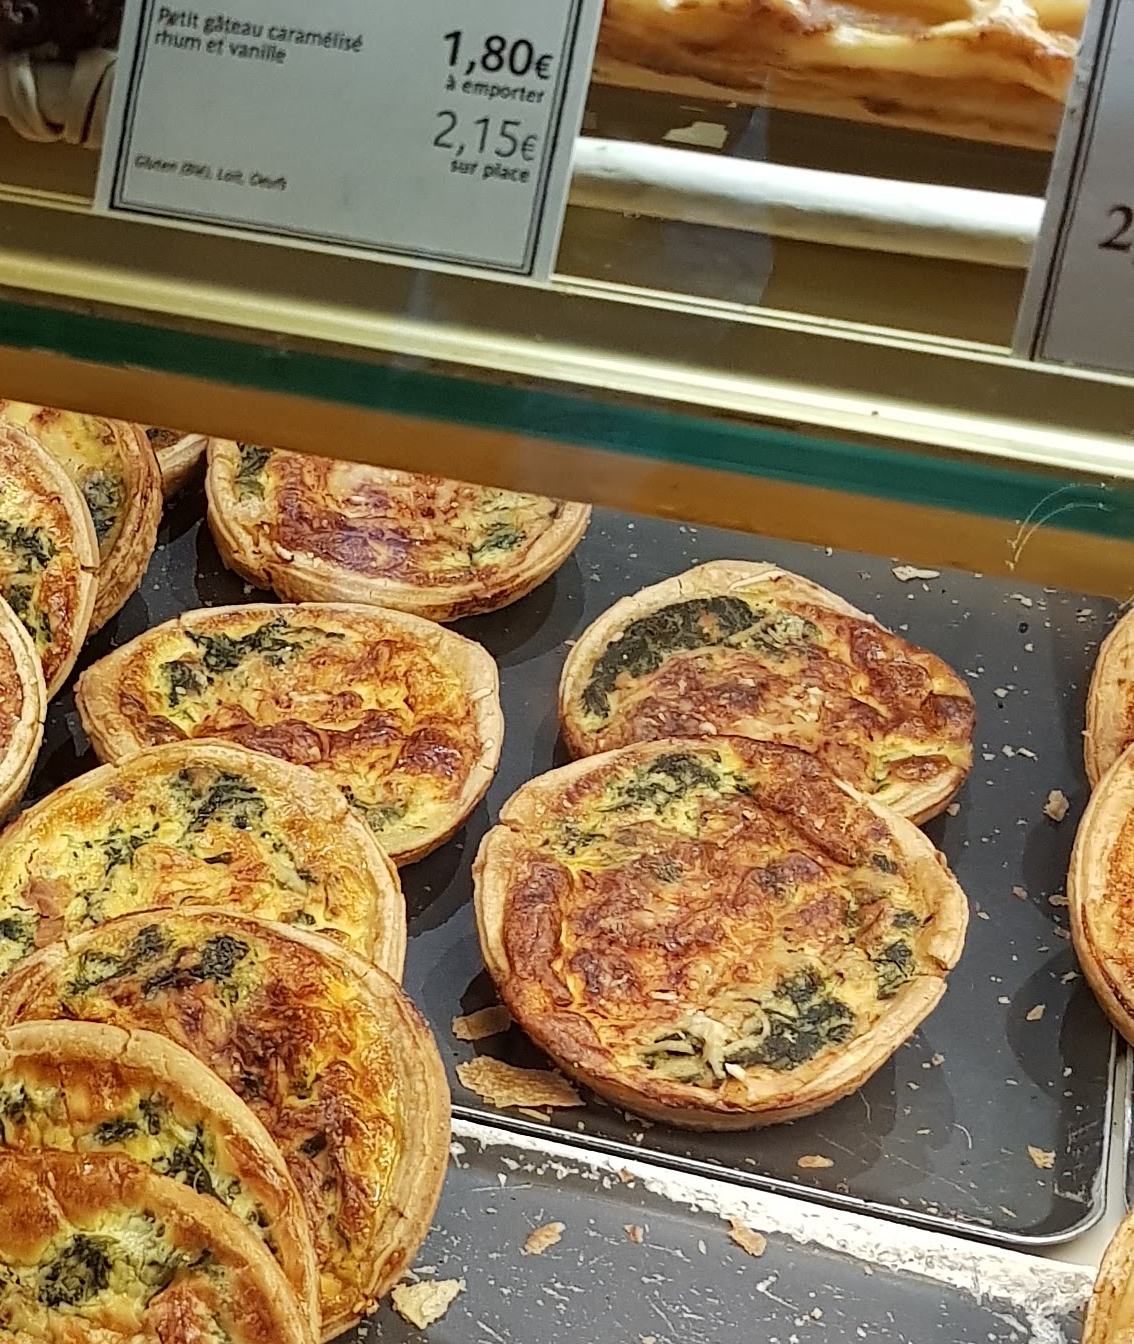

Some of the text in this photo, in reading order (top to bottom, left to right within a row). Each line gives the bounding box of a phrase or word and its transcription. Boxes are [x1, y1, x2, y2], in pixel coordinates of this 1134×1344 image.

[154, 29, 287, 65] rhum et vanille
[157, 6, 365, 54] Petit gâteau caramélisé
[443, 29, 554, 80] 1,80€
[445, 73, 546, 104] à emporter
[433, 109, 538, 162] 2,15€
[449, 159, 531, 184] sur place
[1097, 205, 1134, 253] 2
